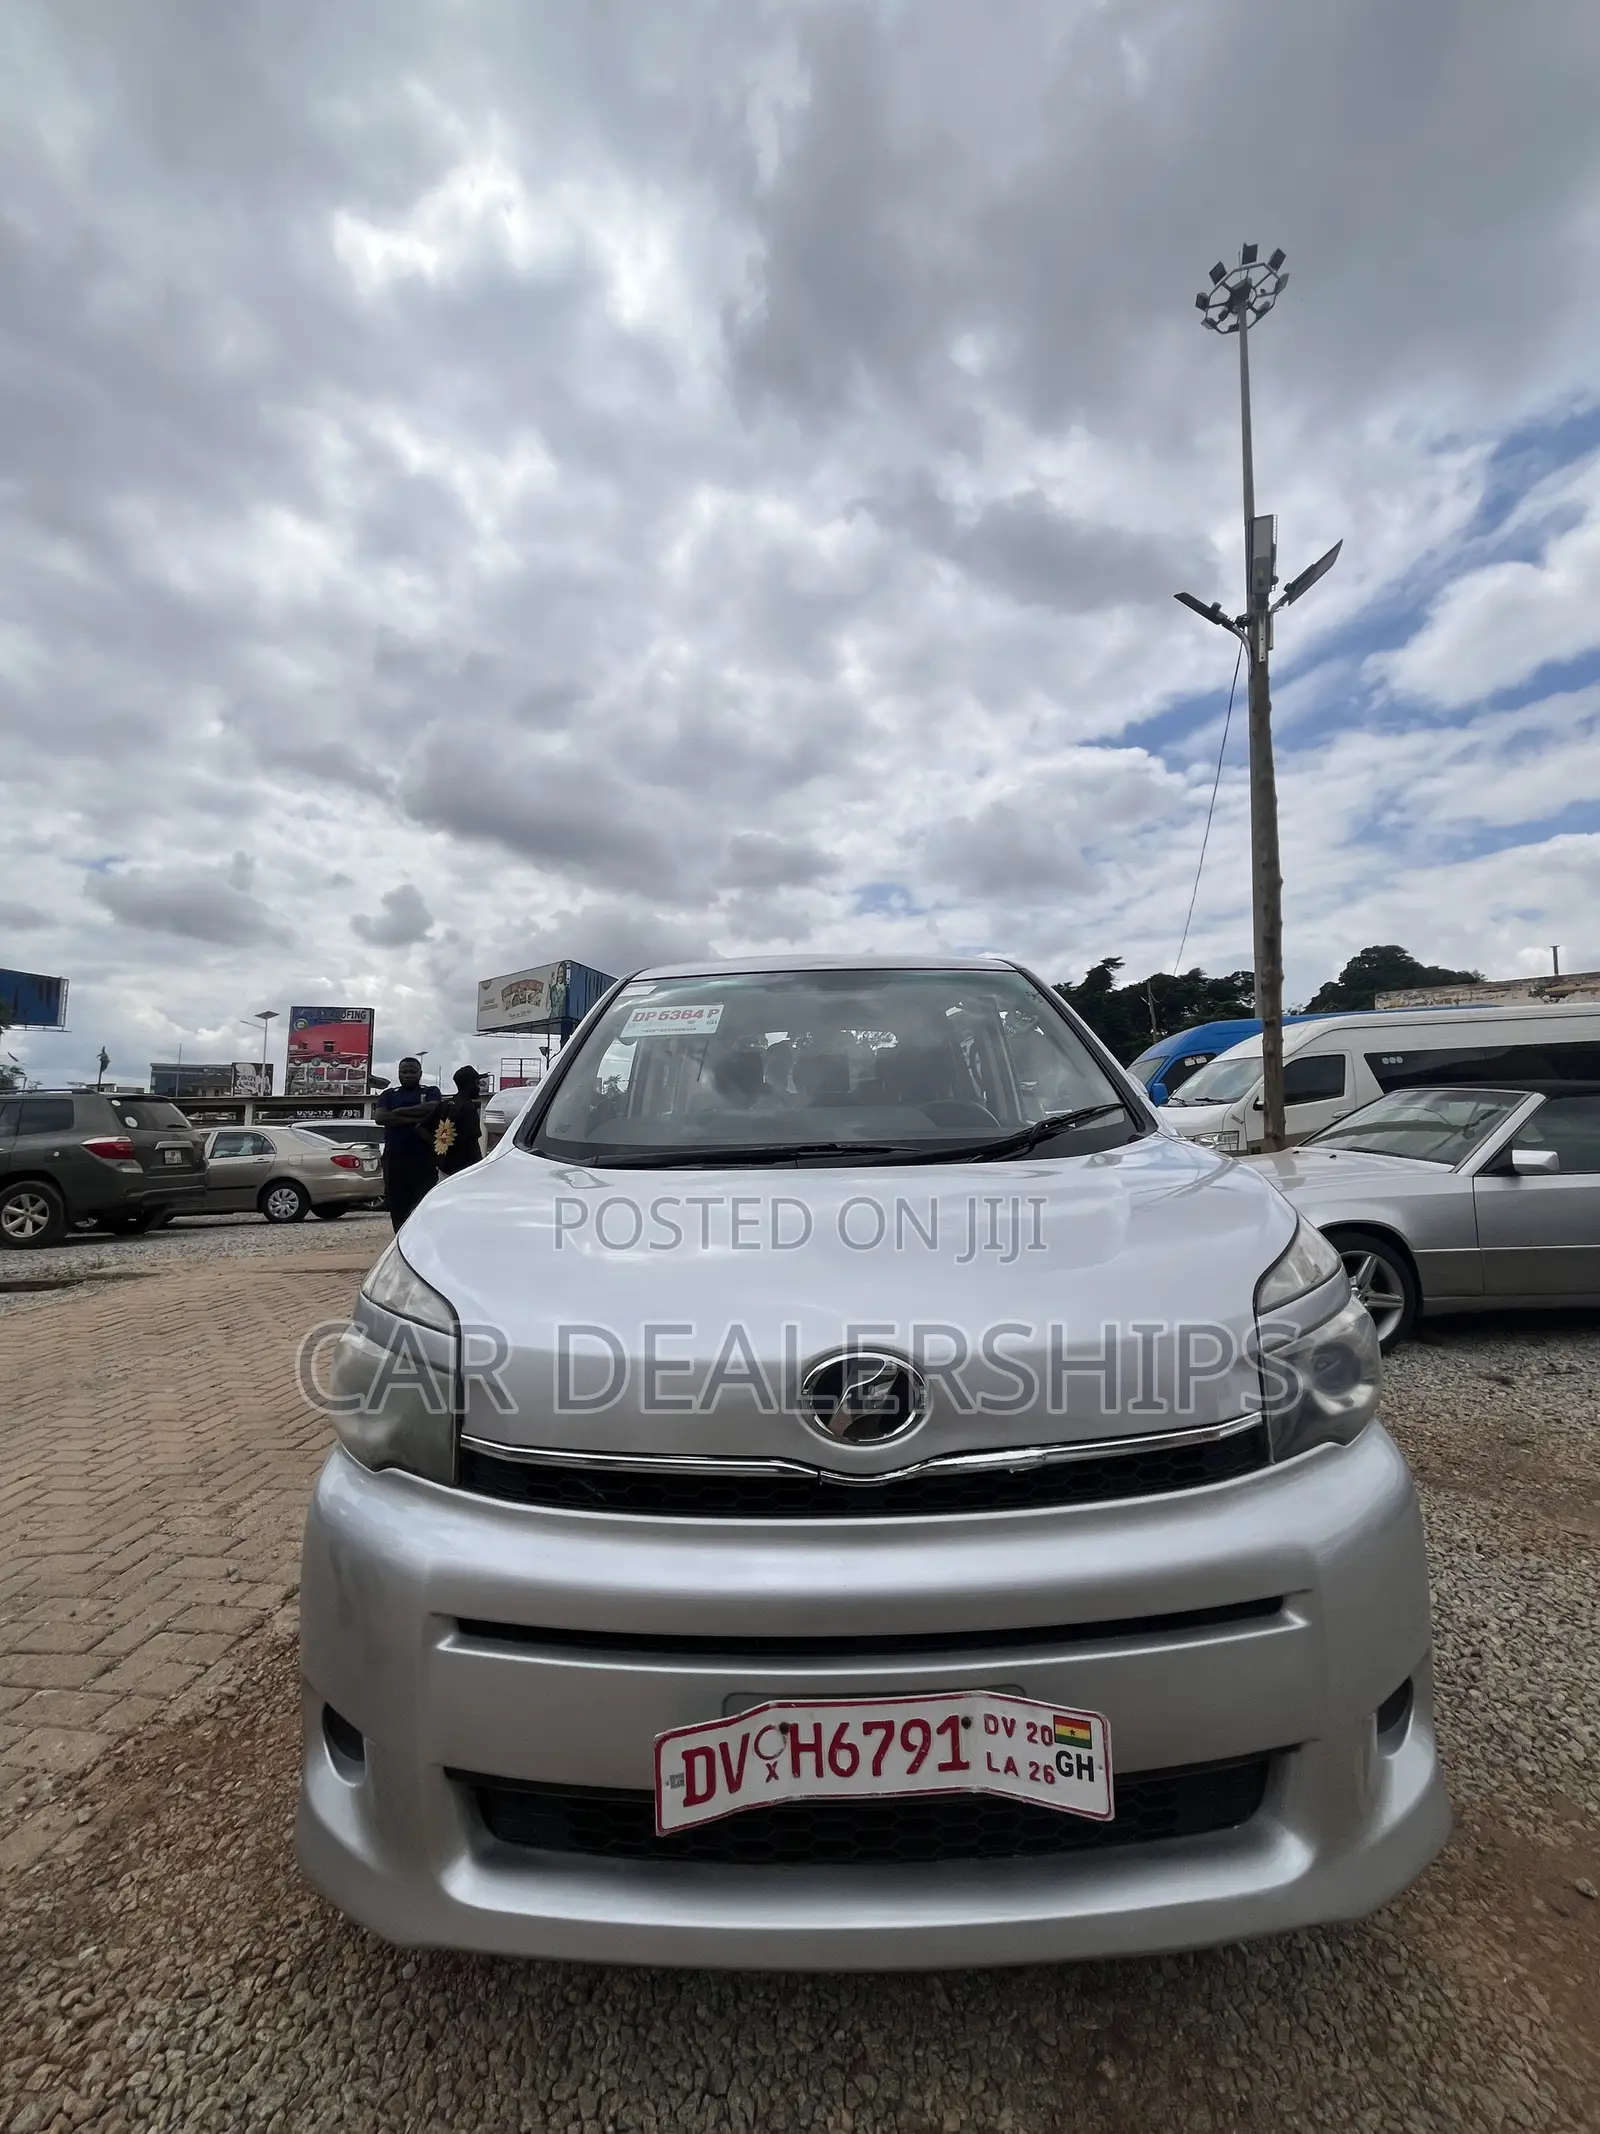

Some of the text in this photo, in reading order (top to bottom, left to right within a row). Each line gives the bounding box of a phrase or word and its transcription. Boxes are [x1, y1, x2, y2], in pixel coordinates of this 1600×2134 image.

[632, 1011, 657, 1022] DP
[983, 1713, 1053, 1746] DV 20
[681, 1732, 750, 1808] DV
[789, 1714, 970, 1778] H6791
[986, 1751, 1055, 1785] LA 26
[1055, 1750, 1095, 1782] GH
